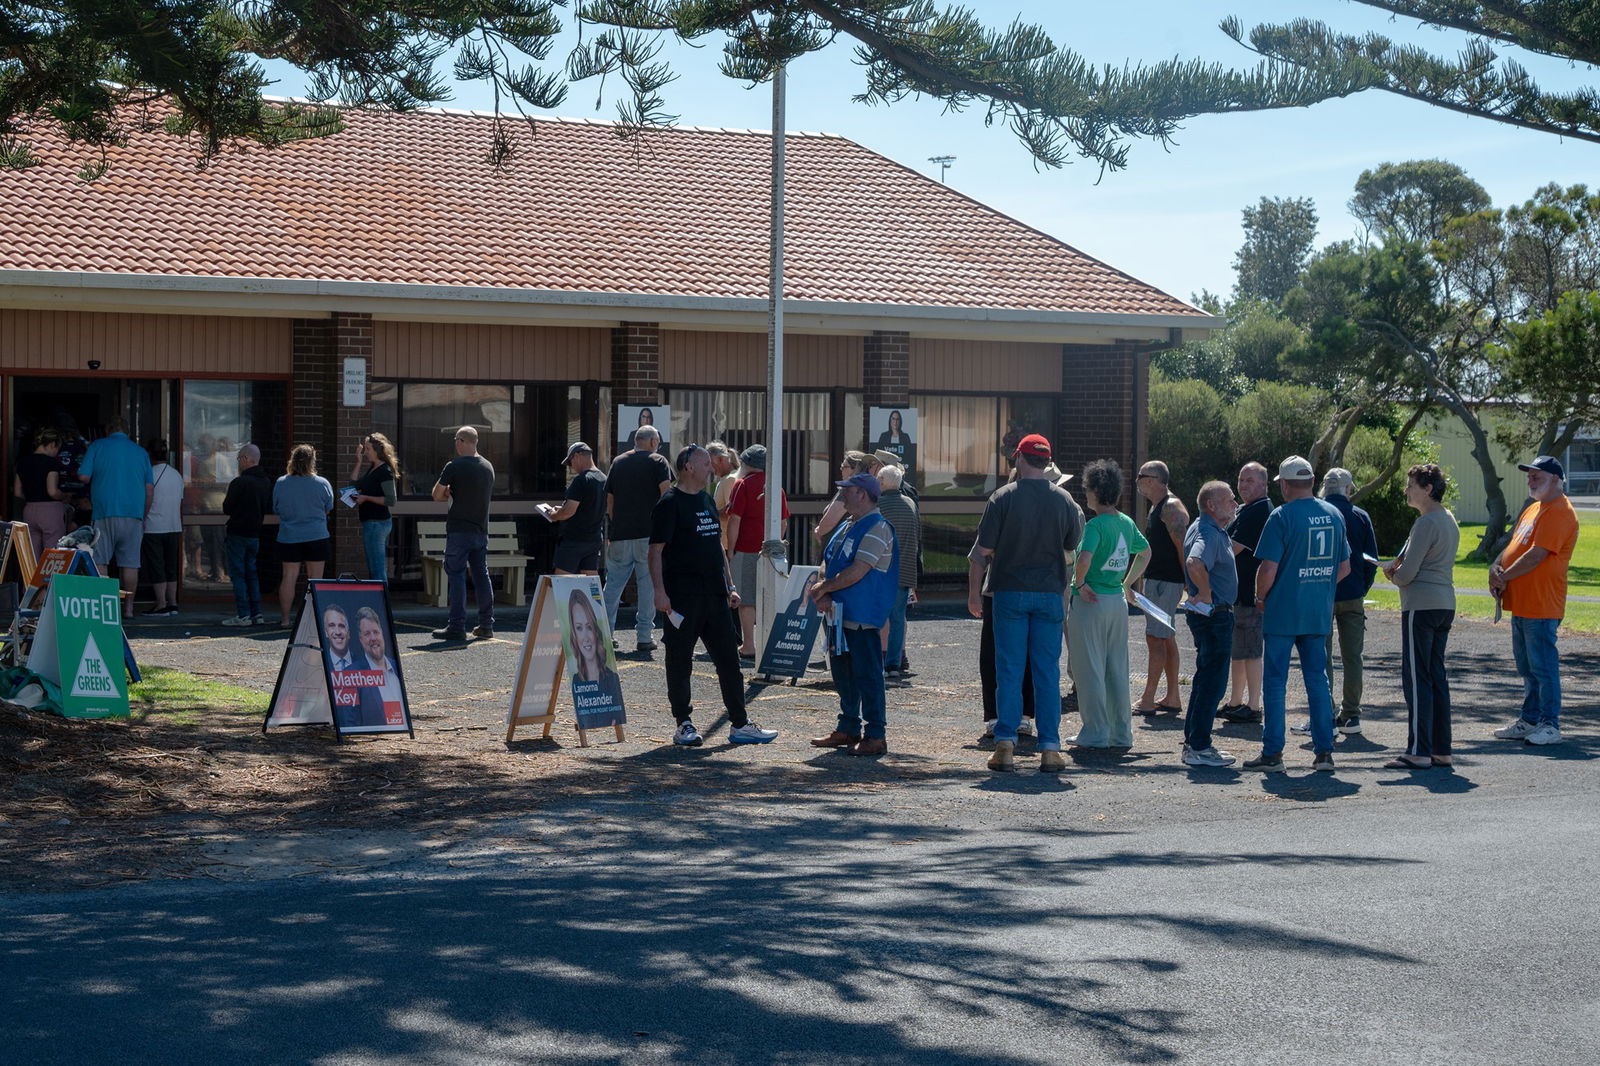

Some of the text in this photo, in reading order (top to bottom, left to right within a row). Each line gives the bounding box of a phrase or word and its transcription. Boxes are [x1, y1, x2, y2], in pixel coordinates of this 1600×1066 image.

[1308, 515, 1332, 525] VOTE
[1316, 530, 1326, 556] 1
[59, 596, 101, 620] VOTE
[787, 619, 801, 628] Vote
[784, 631, 802, 641] Kate
[775, 640, 805, 651] Amoroso
[85, 658, 101, 674] THE
[77, 675, 112, 692] GREENS
[330, 671, 385, 687] Matthew
[573, 683, 599, 693] Lamorna
[333, 688, 358, 708] Key
[577, 693, 613, 708] Alexander
